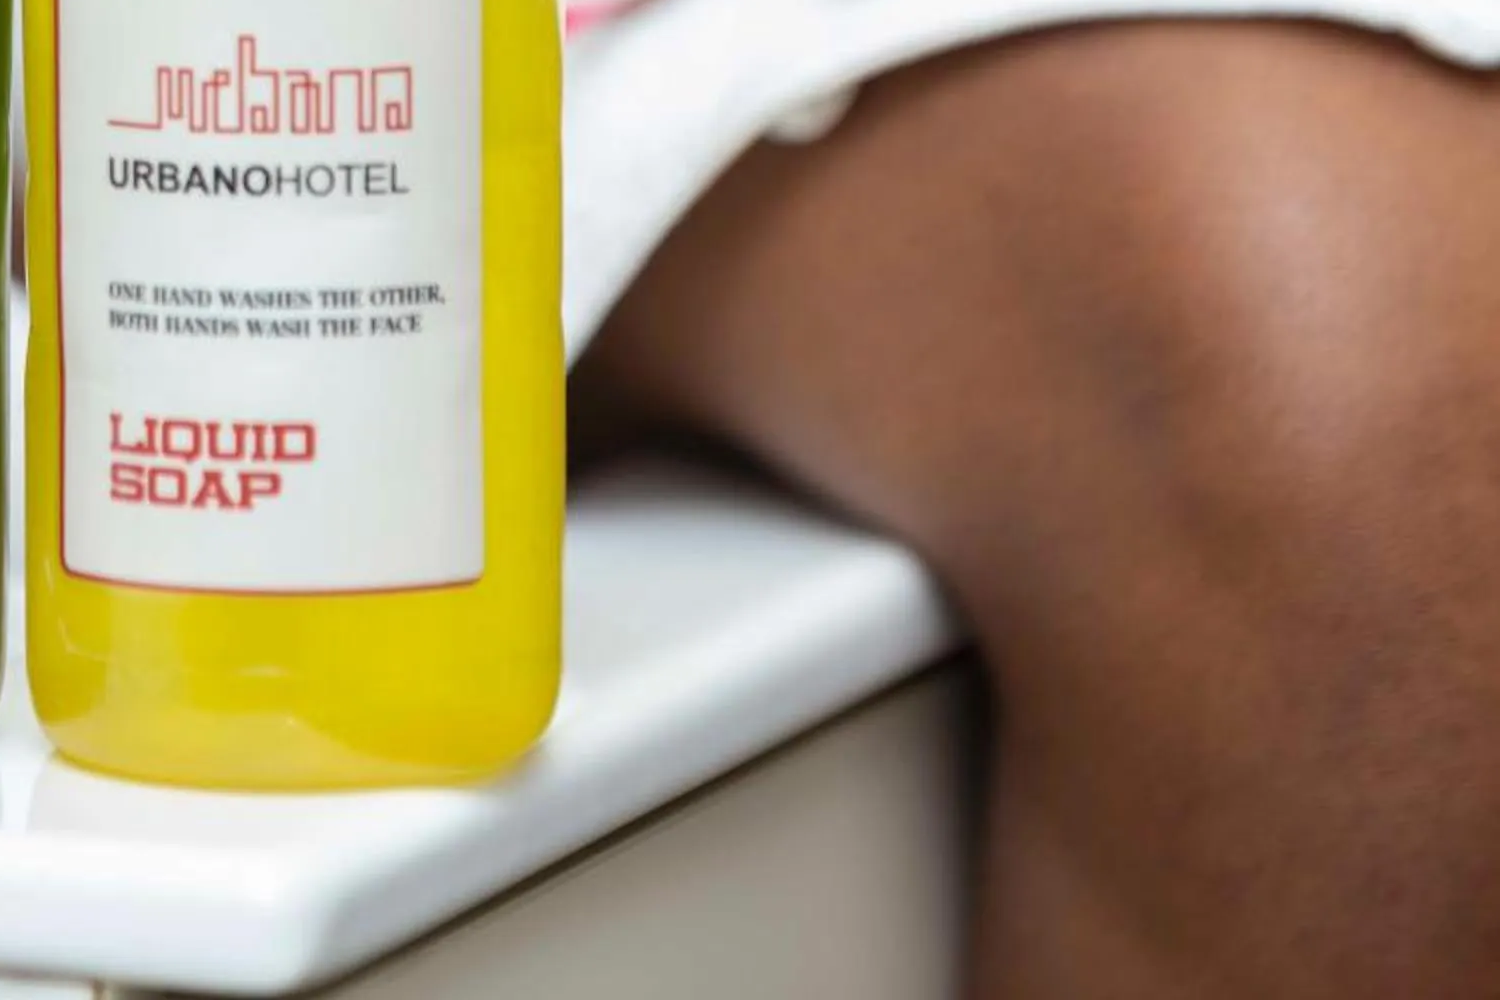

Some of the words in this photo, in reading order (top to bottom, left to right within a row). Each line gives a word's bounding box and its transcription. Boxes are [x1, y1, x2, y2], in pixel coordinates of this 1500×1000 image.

[107, 156, 409, 197] URBANOHOTEL
[108, 281, 147, 302] ONE
[153, 286, 212, 308] HAND
[218, 289, 312, 310] WASHES
[319, 289, 362, 308] THE
[369, 284, 446, 306] OTHER,
[108, 309, 158, 333] BOTH
[165, 314, 240, 337] HANDS
[246, 317, 311, 338] WASH
[318, 317, 362, 338] THE
[370, 313, 422, 335] FACE
[109, 412, 318, 464] LIQUID
[109, 463, 282, 510] SOAP
